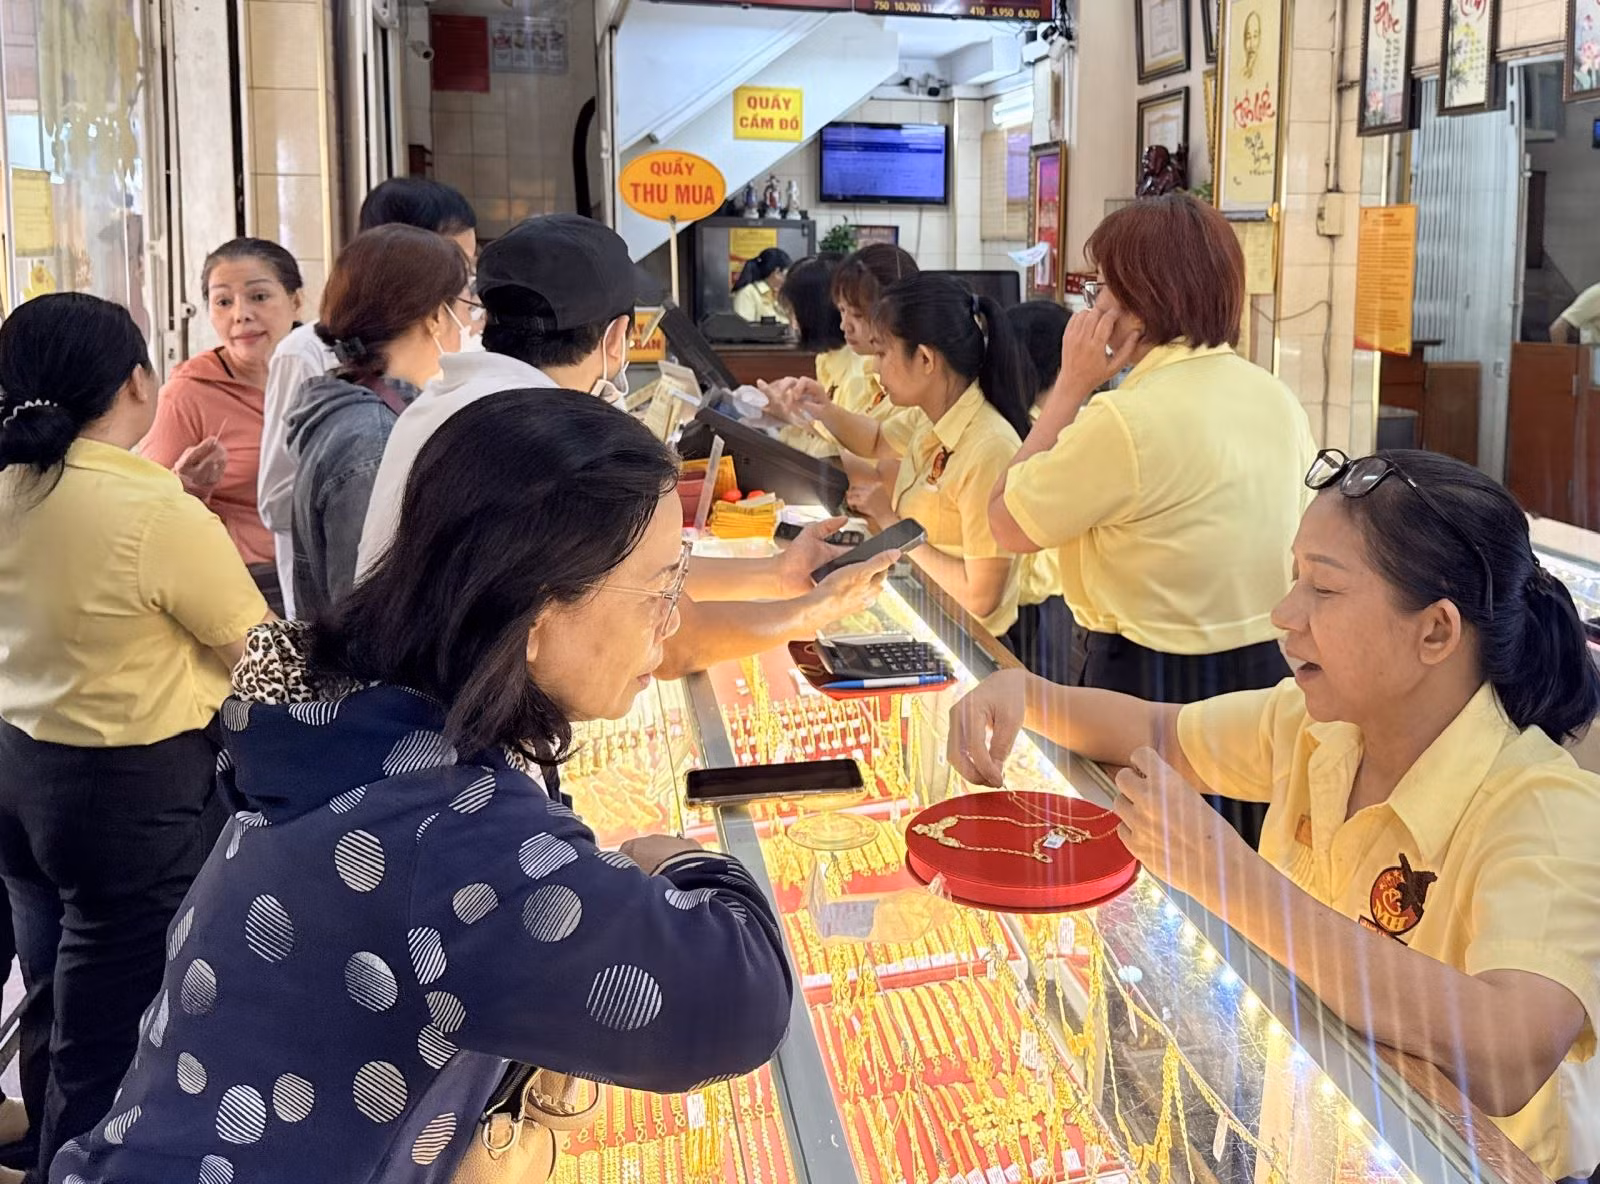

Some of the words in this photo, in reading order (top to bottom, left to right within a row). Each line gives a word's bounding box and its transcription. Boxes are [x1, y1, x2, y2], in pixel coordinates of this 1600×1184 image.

[969, 6, 986, 16] 410
[630, 182, 668, 204] THU
[675, 183, 716, 205] MUA
